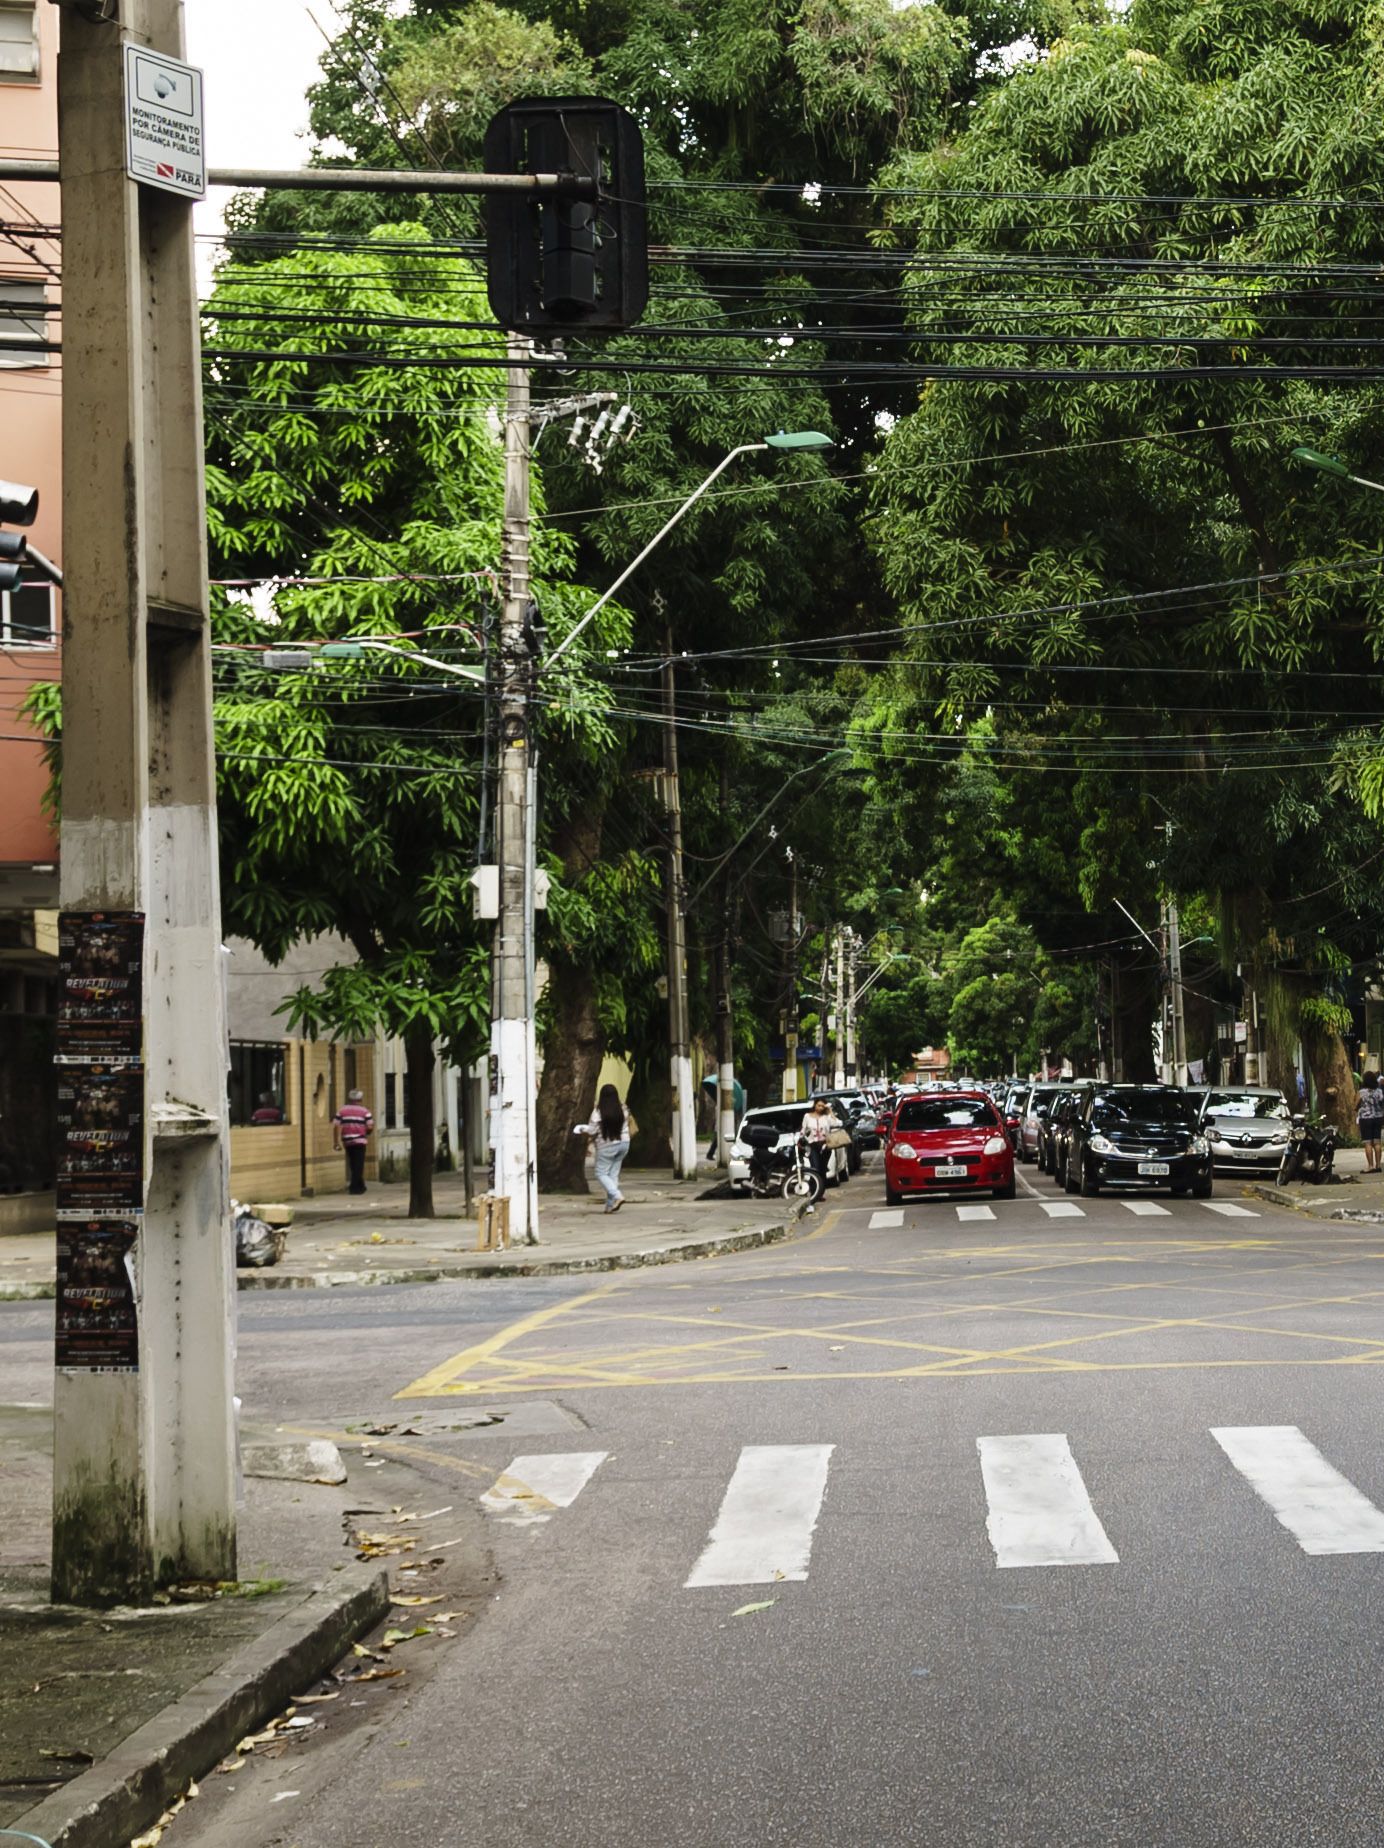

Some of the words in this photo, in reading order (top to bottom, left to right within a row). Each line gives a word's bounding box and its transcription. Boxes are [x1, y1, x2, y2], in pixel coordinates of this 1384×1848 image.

[132, 107, 200, 136] MONITORAMENTO
[132, 117, 149, 130] POR
[189, 136, 200, 146] DE
[132, 128, 171, 149] SEGURANÇA
